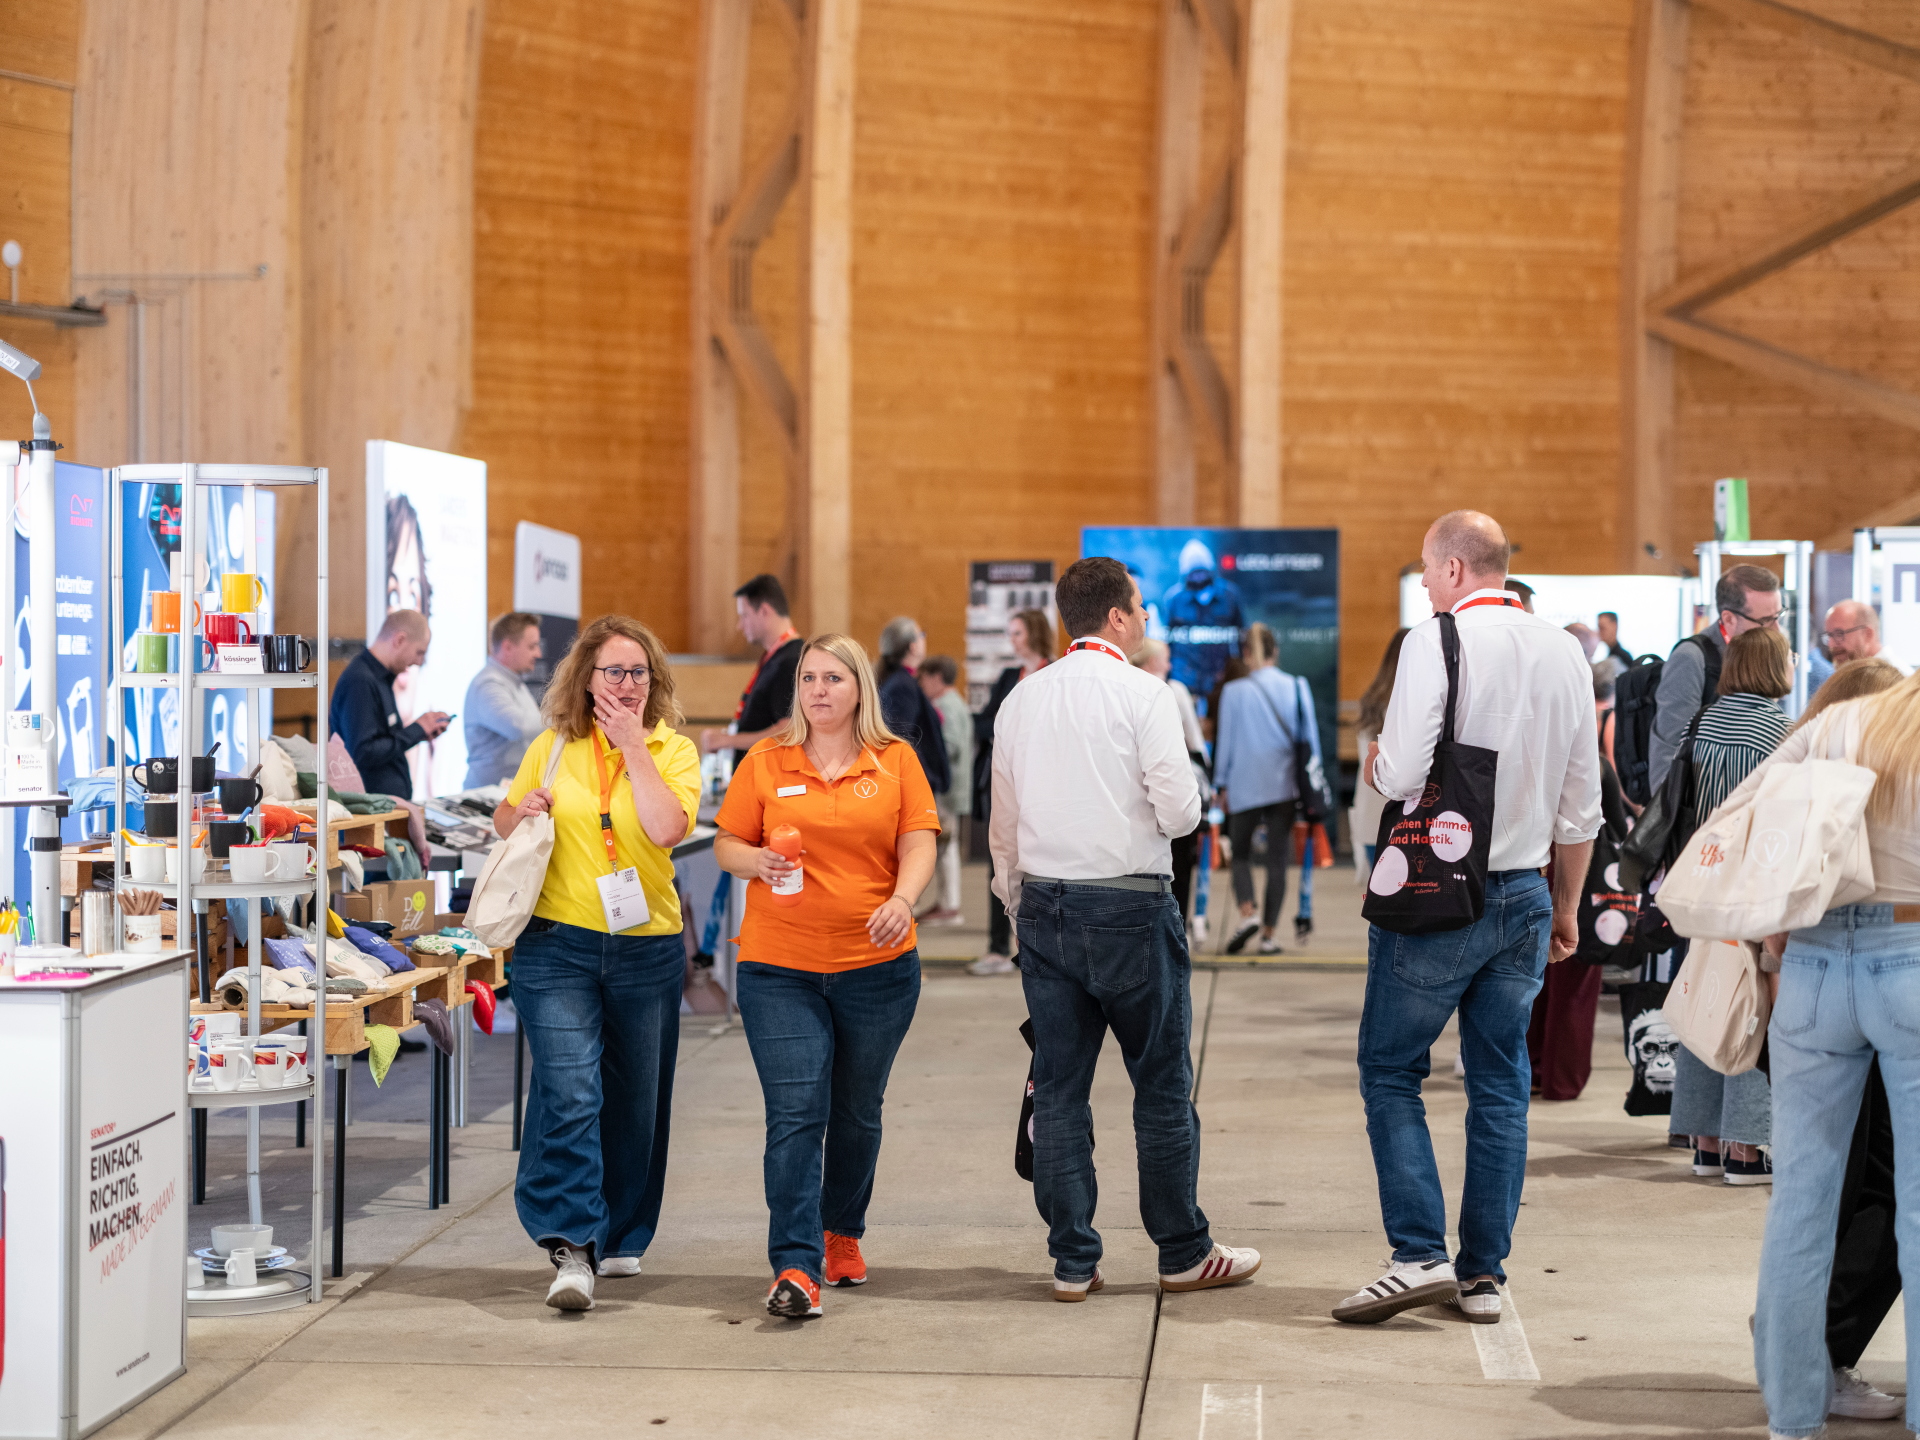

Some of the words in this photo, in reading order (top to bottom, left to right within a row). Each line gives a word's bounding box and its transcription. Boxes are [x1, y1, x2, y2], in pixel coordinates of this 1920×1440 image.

[223, 655, 257, 663] kössinger
[1411, 833, 1453, 846] Haptik.
[1426, 818, 1472, 833] Himmel
[91, 1140, 143, 1182] EINFACH.
[90, 1173, 139, 1215] RICHTIG.
[89, 1204, 143, 1248] MACHEN.
[100, 1236, 126, 1284] MADE
[127, 1228, 138, 1254] IN
